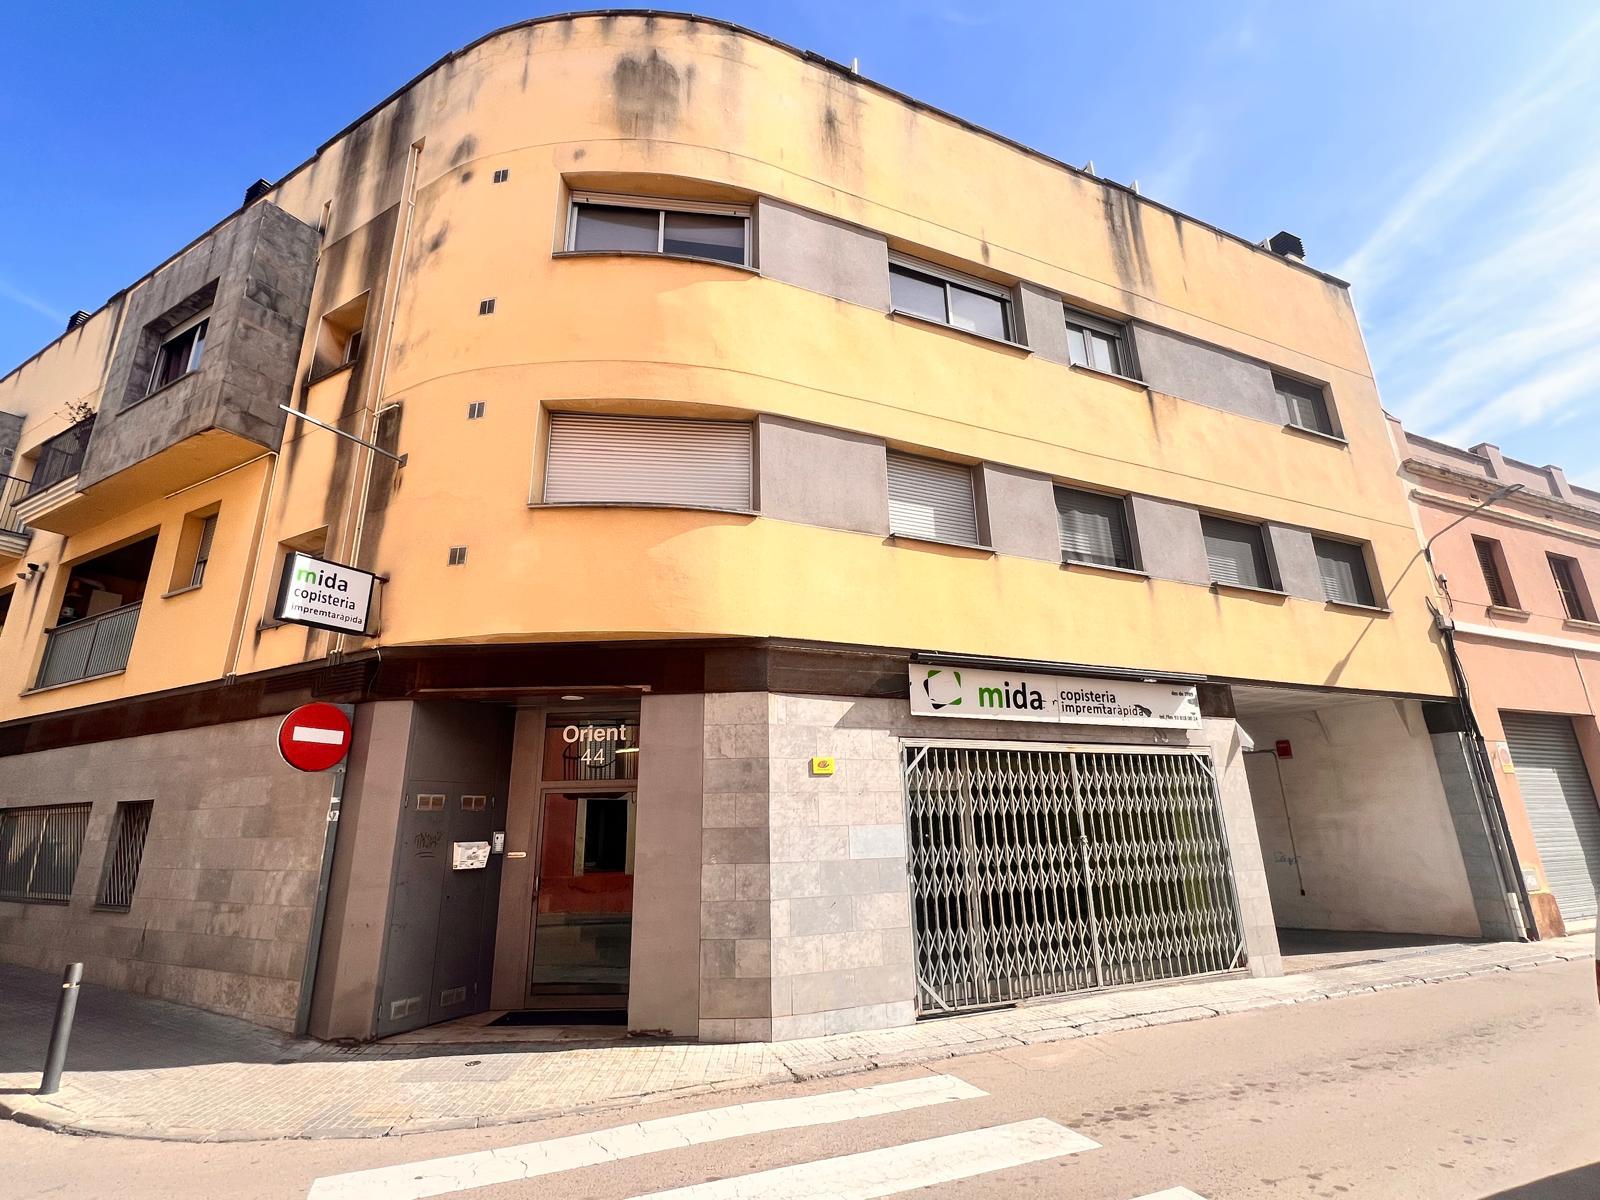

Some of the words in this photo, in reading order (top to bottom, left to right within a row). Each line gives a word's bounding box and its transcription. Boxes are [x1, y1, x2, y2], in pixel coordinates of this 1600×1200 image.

[297, 569, 348, 592] mida
[294, 588, 356, 610] copisteria
[978, 681, 1043, 710] mida
[1060, 689, 1116, 704] copisteria
[1061, 701, 1145, 717] impremtaràpida
[563, 724, 626, 743] Orient
[581, 748, 605, 765] 44
